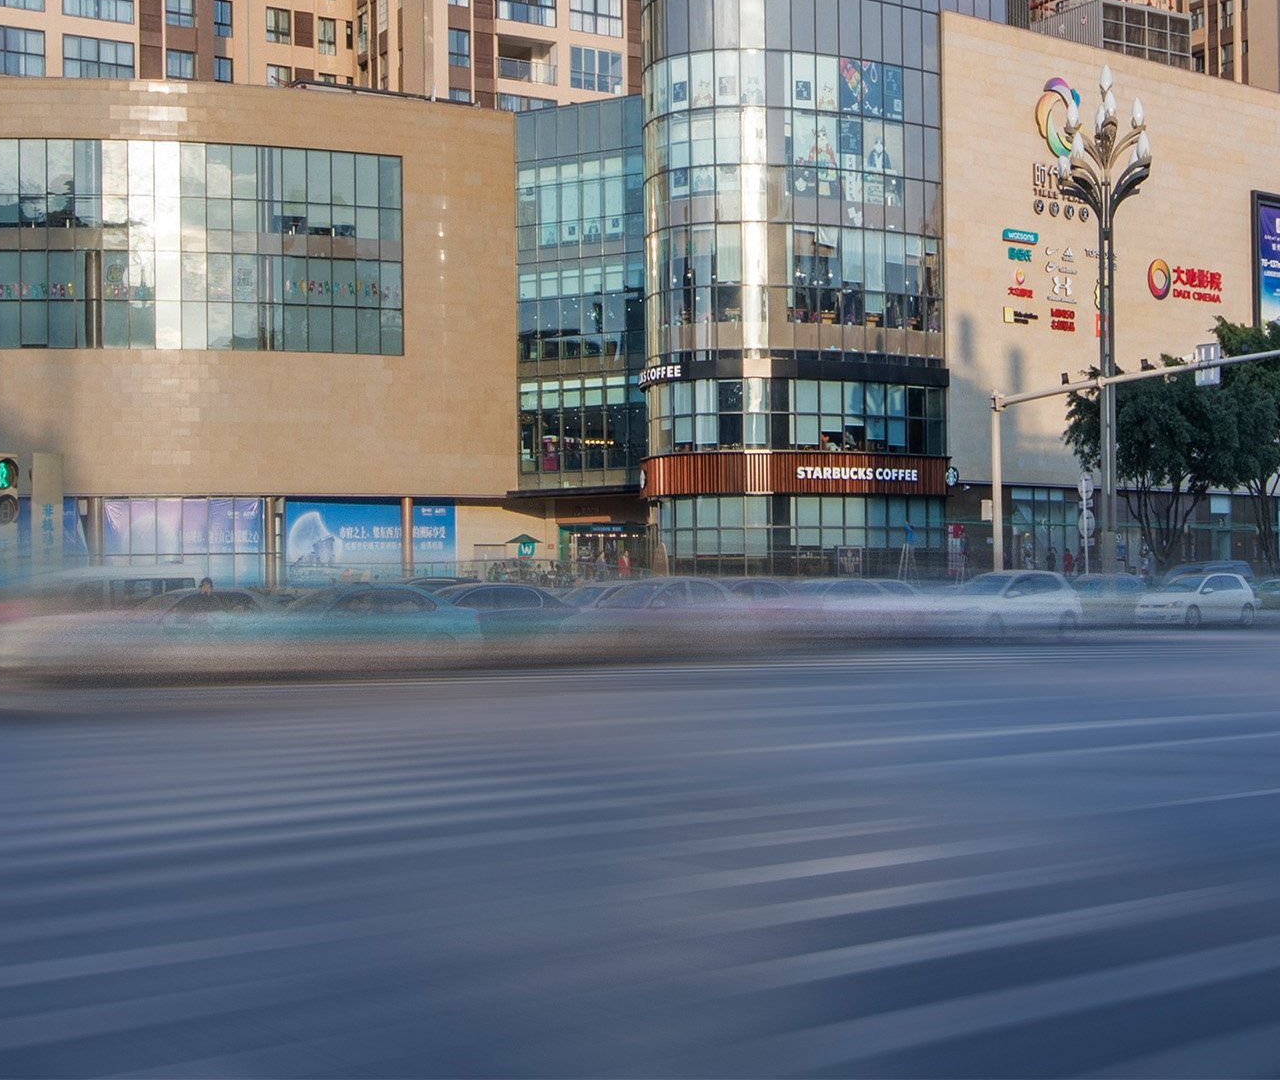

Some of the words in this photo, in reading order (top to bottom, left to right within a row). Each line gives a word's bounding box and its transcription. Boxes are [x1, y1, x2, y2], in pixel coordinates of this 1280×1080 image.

[1008, 232, 1035, 242] watsons
[1172, 266, 1222, 292] 大地影院
[1172, 288, 1191, 300] DADI
[1192, 291, 1222, 304] CINEMA
[647, 364, 682, 381] COFFEE
[796, 467, 874, 481] STARBUCKS
[875, 469, 919, 482] COFFEE
